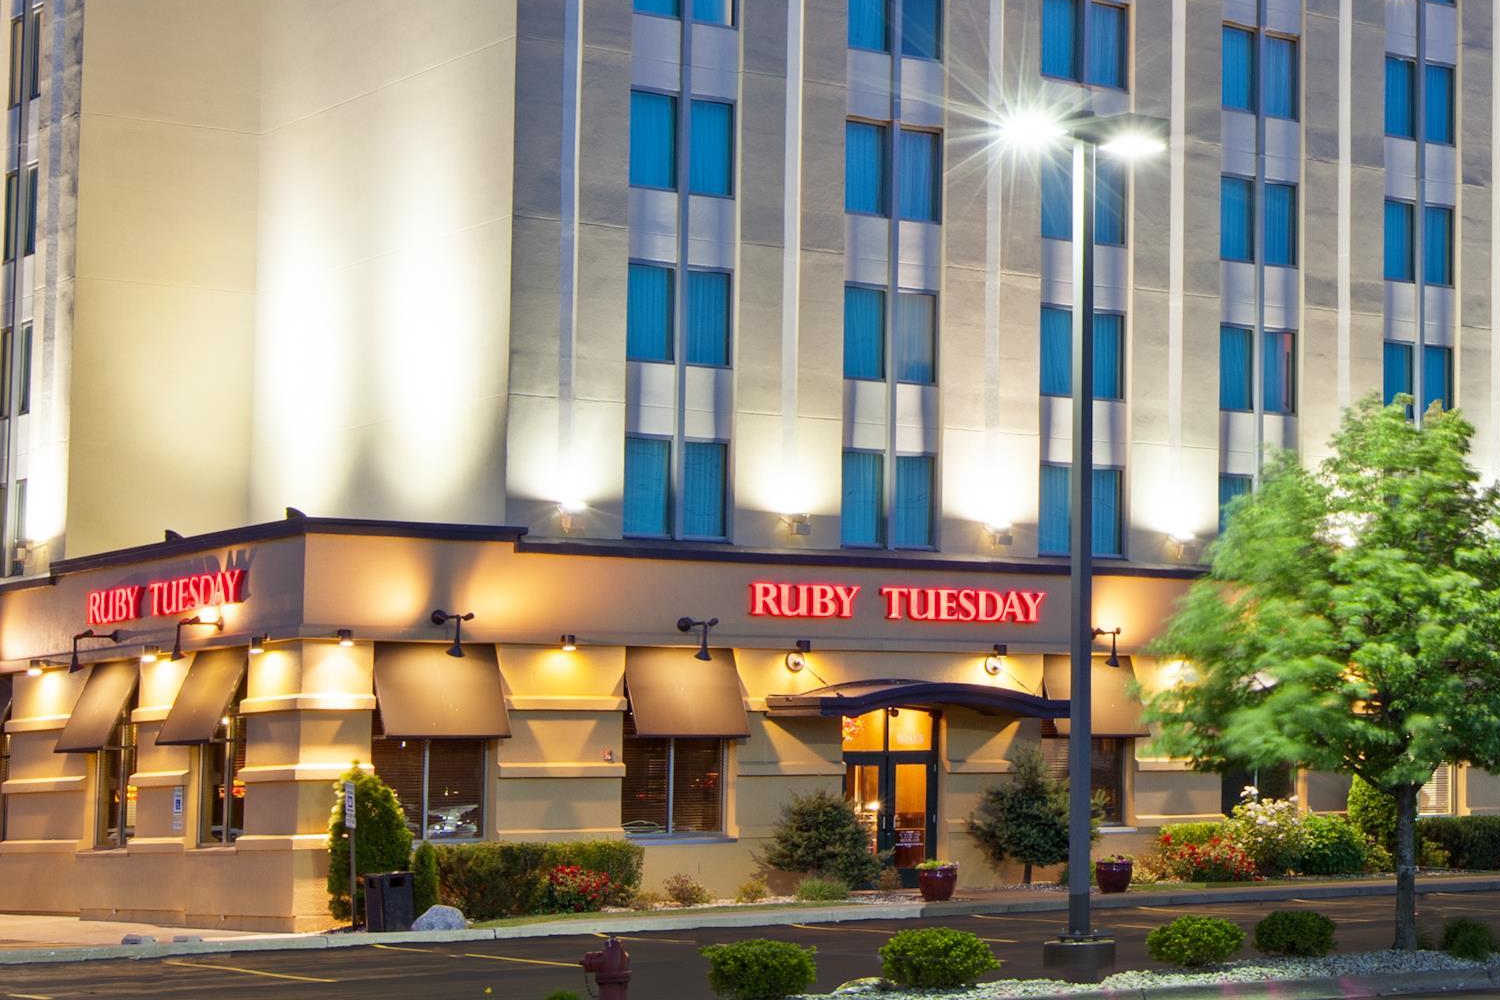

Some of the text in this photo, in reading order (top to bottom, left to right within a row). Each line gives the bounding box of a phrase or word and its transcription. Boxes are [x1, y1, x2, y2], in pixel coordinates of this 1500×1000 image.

[88, 569, 243, 625] RUBY TUESDAY
[750, 582, 1047, 623] RUBY TUESDAY
